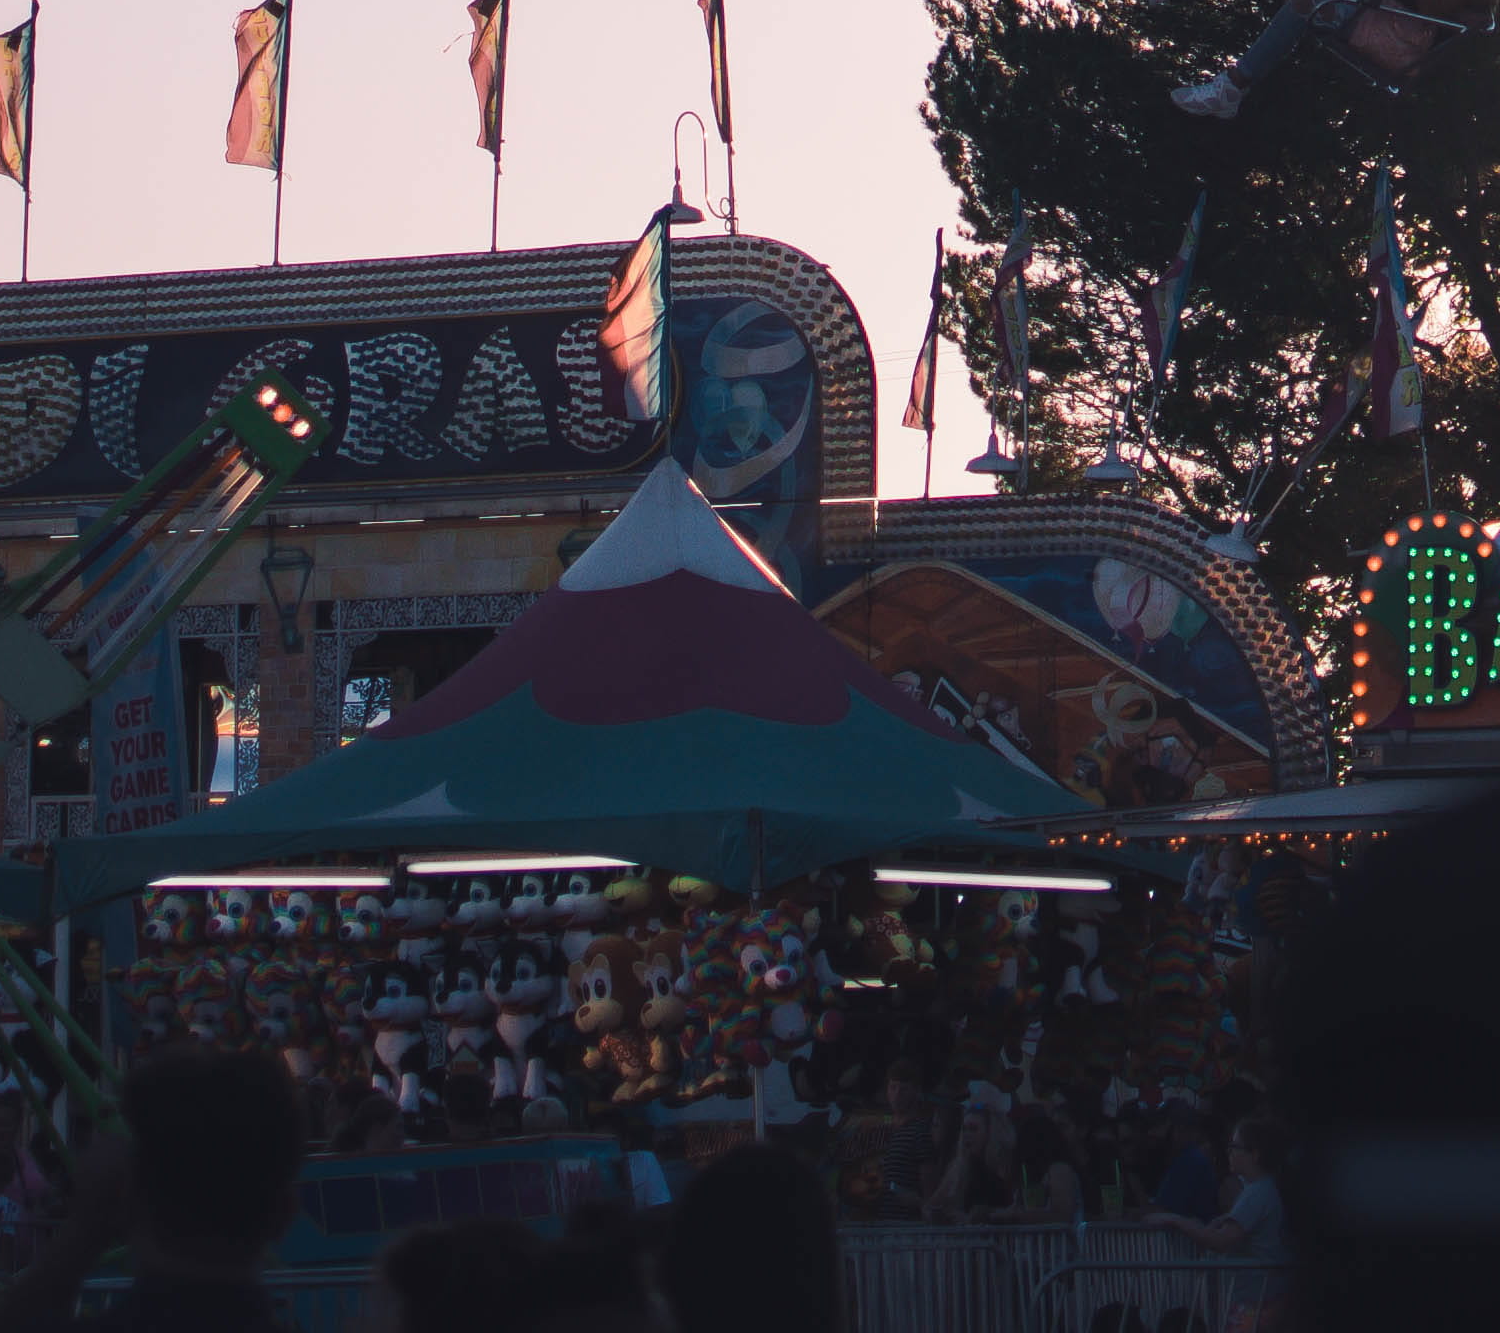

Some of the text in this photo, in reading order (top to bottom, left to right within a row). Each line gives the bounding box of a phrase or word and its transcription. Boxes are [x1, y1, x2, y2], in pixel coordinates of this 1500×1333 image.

[115, 695, 152, 729] GET
[111, 731, 167, 765] YOUR
[110, 767, 170, 803] GAME
[106, 801, 178, 834] CARDS
